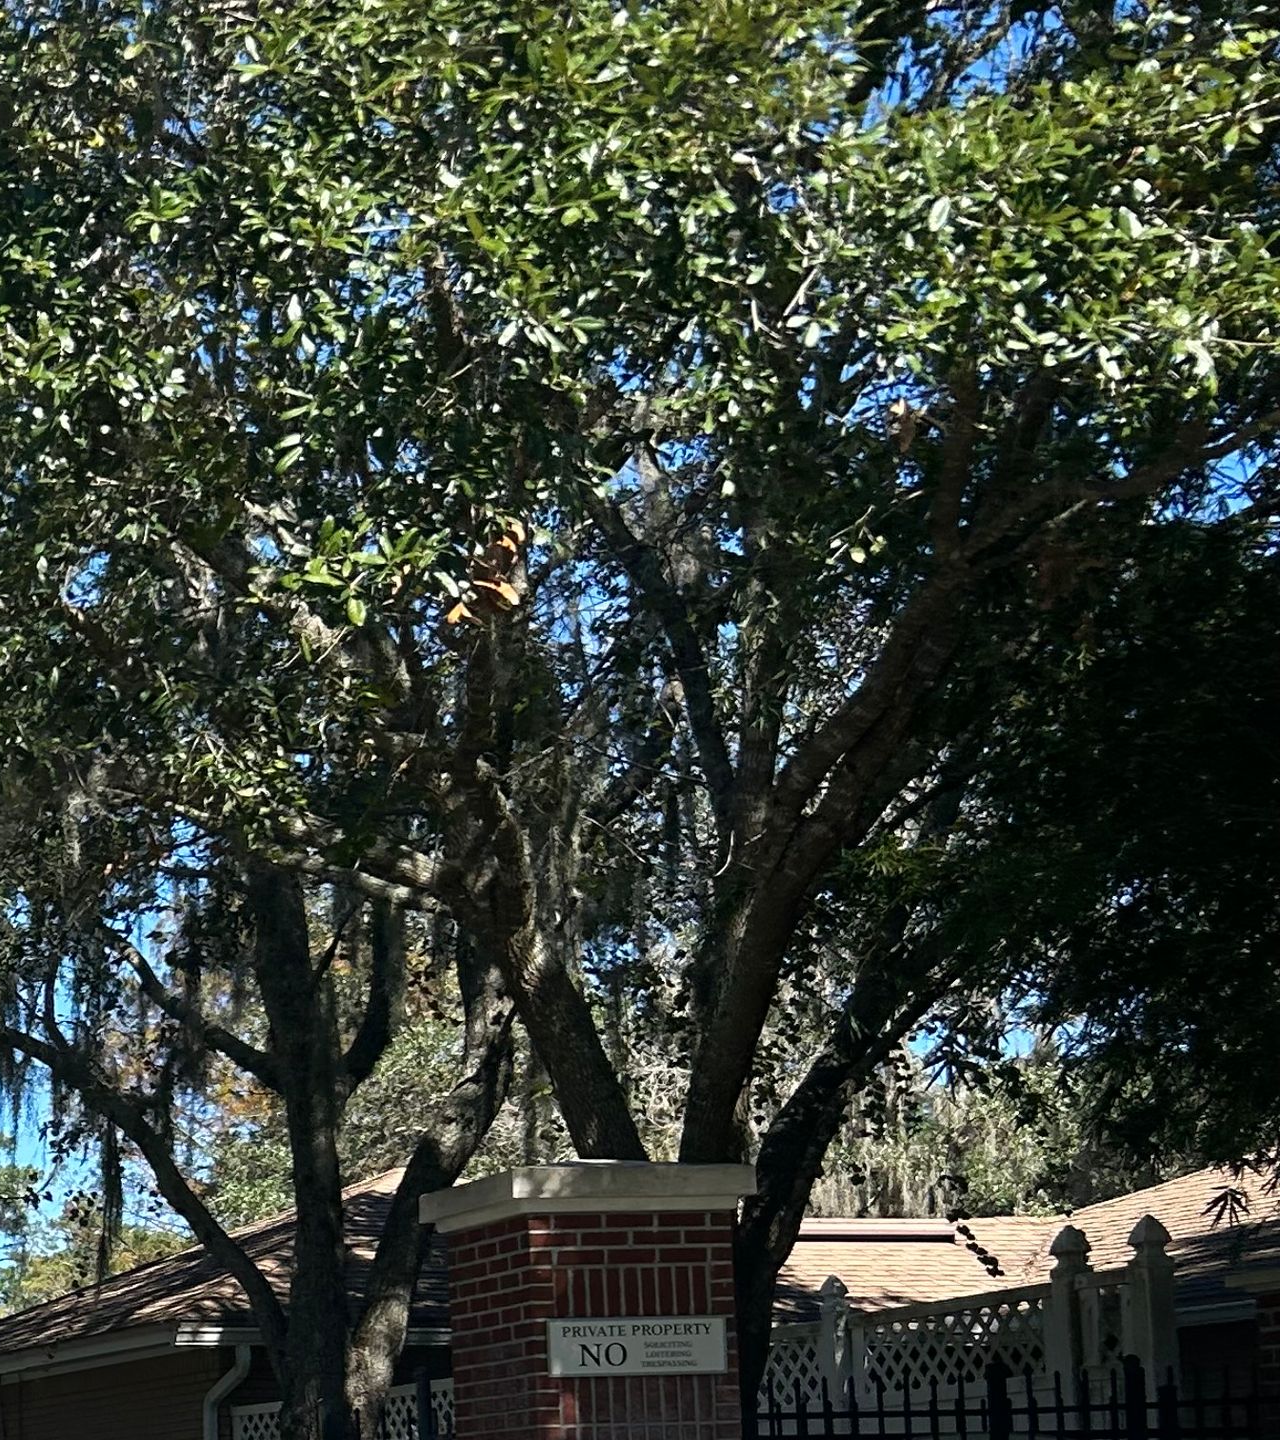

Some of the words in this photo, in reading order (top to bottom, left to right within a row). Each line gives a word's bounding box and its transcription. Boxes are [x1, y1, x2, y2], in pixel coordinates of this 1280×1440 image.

[561, 1325, 627, 1338] PRIVATE
[631, 1323, 713, 1336] PROPERTY
[578, 1342, 628, 1367] NO
